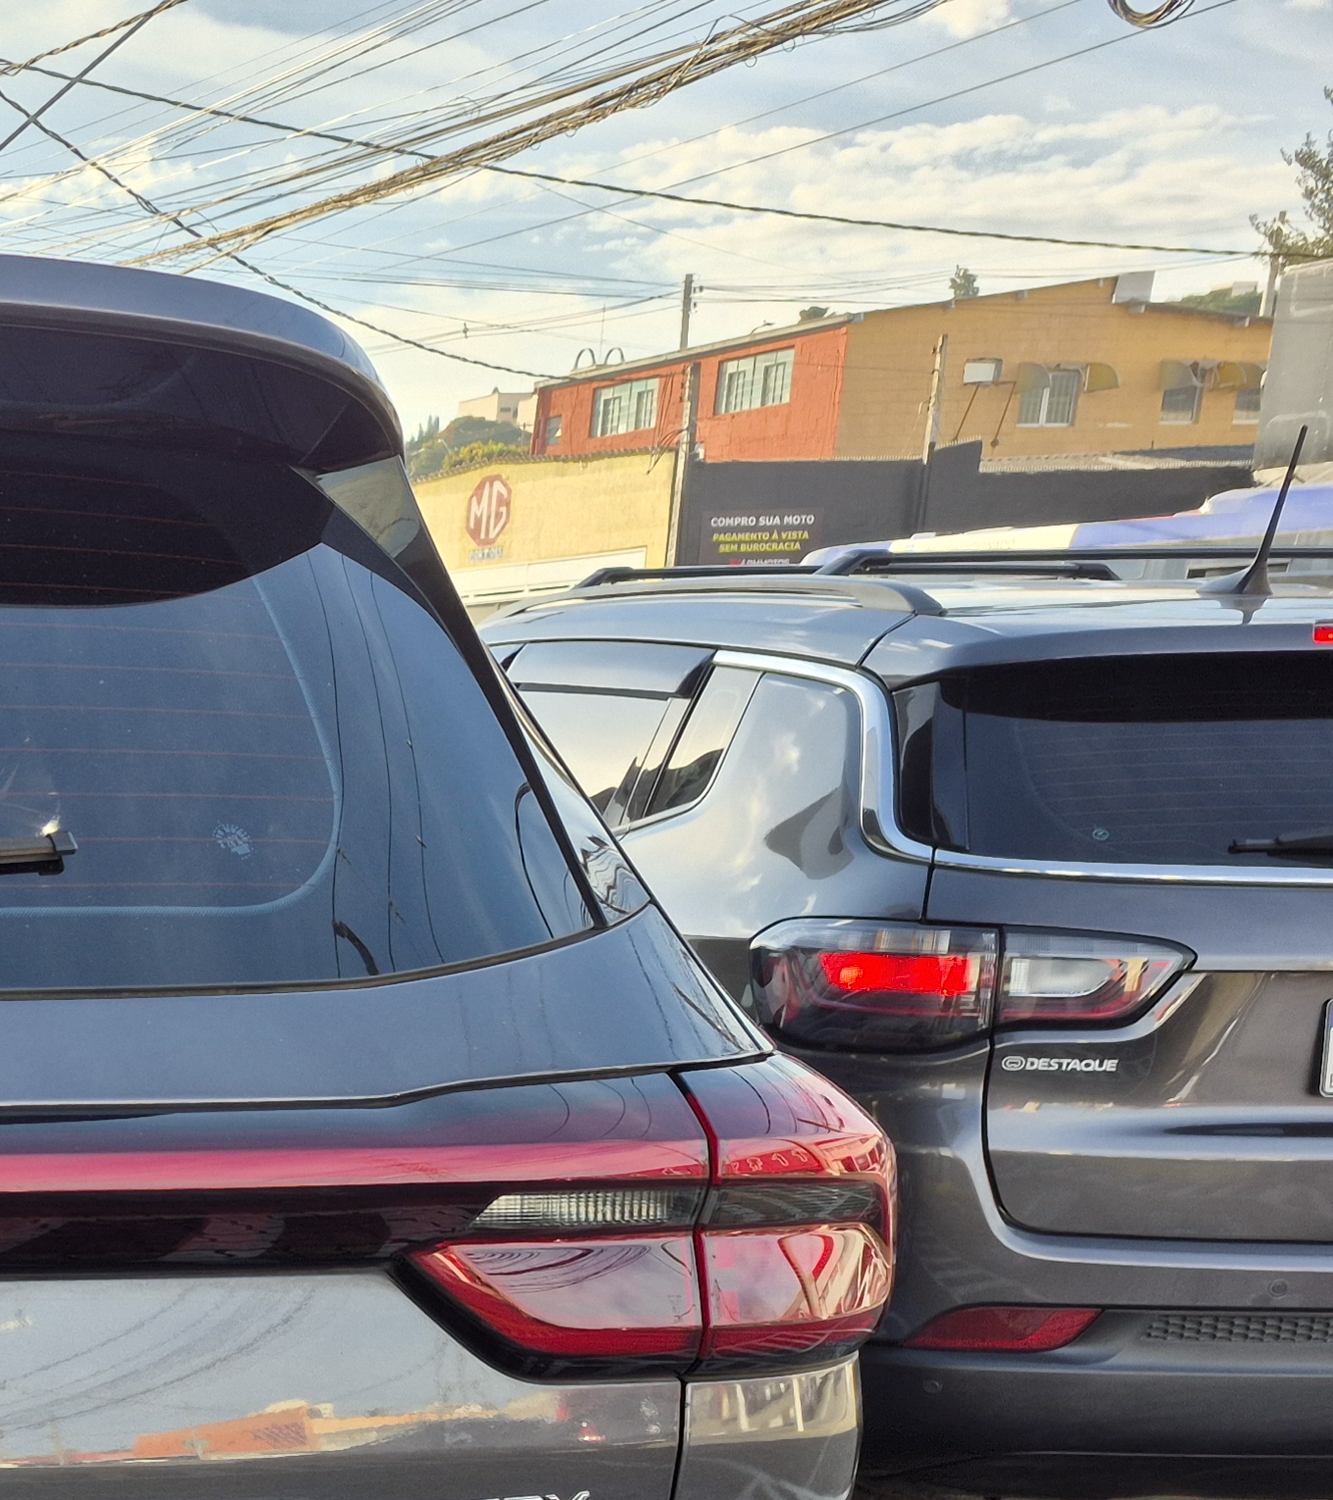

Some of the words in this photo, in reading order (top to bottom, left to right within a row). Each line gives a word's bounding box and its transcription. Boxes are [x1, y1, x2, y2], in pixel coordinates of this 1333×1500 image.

[469, 480, 508, 540] MG
[710, 516, 756, 527] COMPRO
[758, 516, 780, 526] SUA
[783, 514, 815, 525] MOTO
[713, 532, 770, 541] PAGAMENTO
[781, 530, 809, 540] VISTA
[719, 544, 738, 553] SEM
[740, 542, 801, 553] BUROCRACIA
[1025, 1057, 1119, 1072] DESTAQUE
